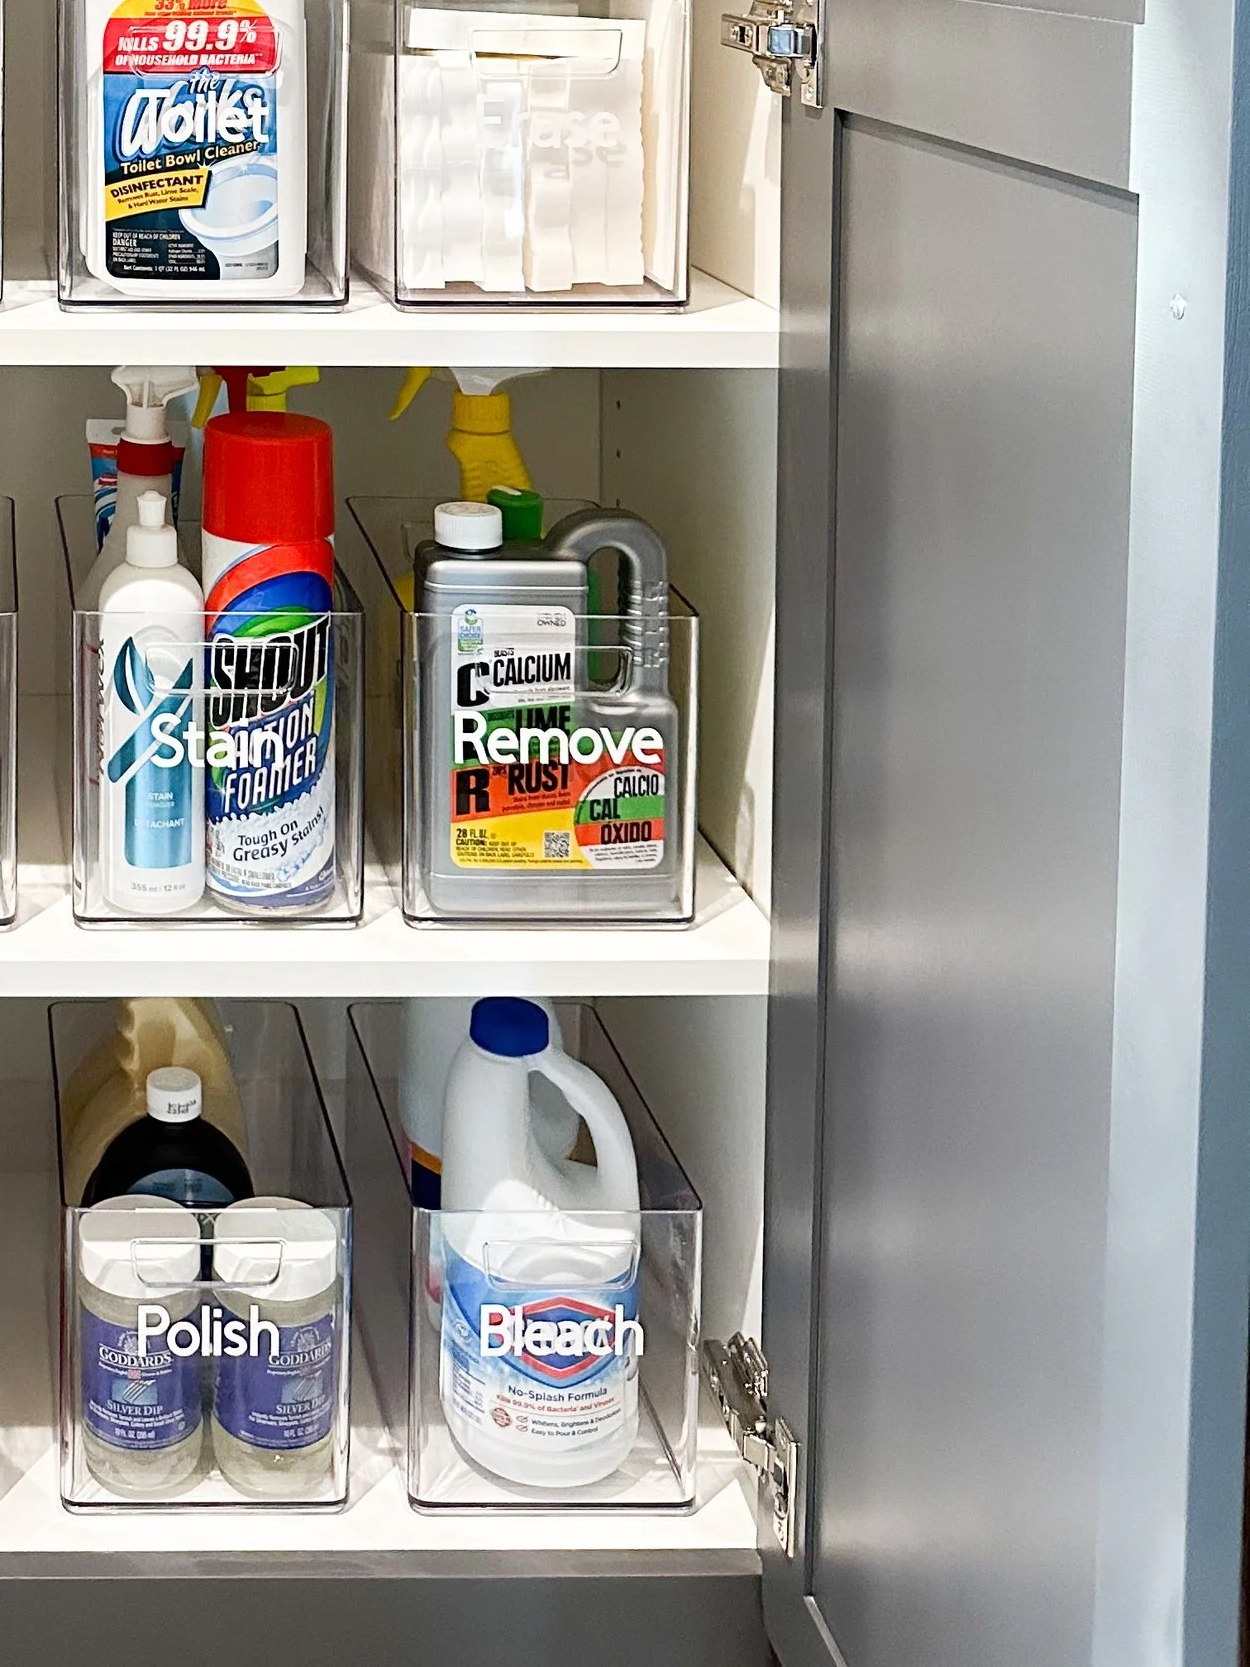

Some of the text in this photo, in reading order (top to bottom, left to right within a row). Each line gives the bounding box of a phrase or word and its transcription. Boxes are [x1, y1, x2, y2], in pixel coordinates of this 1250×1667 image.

[117, 19, 257, 52] KILLS 99.9%
[115, 54, 199, 66] OF HOUSEHOLD
[136, 89, 269, 143] Toilet
[476, 92, 622, 149] Erase
[121, 141, 260, 175] Toilet Bowl Cleaner
[110, 175, 204, 198] DISINFECTANT
[112, 239, 137, 247] DANGER
[210, 611, 332, 730] SHOUT
[456, 652, 571, 708] C CALCIUM
[150, 712, 285, 769] Stain
[453, 710, 664, 766] Remove
[225, 736, 318, 814] FOAMER
[456, 767, 491, 816] R
[507, 760, 571, 796] RUST
[613, 773, 660, 799] CALCIO
[148, 792, 174, 801] STAIN
[589, 798, 621, 821] CAL
[233, 806, 324, 862] Greasy Stains!
[238, 820, 299, 847] Tough On
[455, 838, 488, 847] CAUTION:
[456, 828, 468, 838] 28
[137, 1304, 280, 1358] Polish
[479, 1303, 645, 1357] Bleach
[105, 1399, 164, 1416] SILVER DIP
[275, 1401, 311, 1415] SILVER
[508, 1384, 608, 1403] No-Splash Formula
[512, 1398, 593, 1412] 99.9% of and
